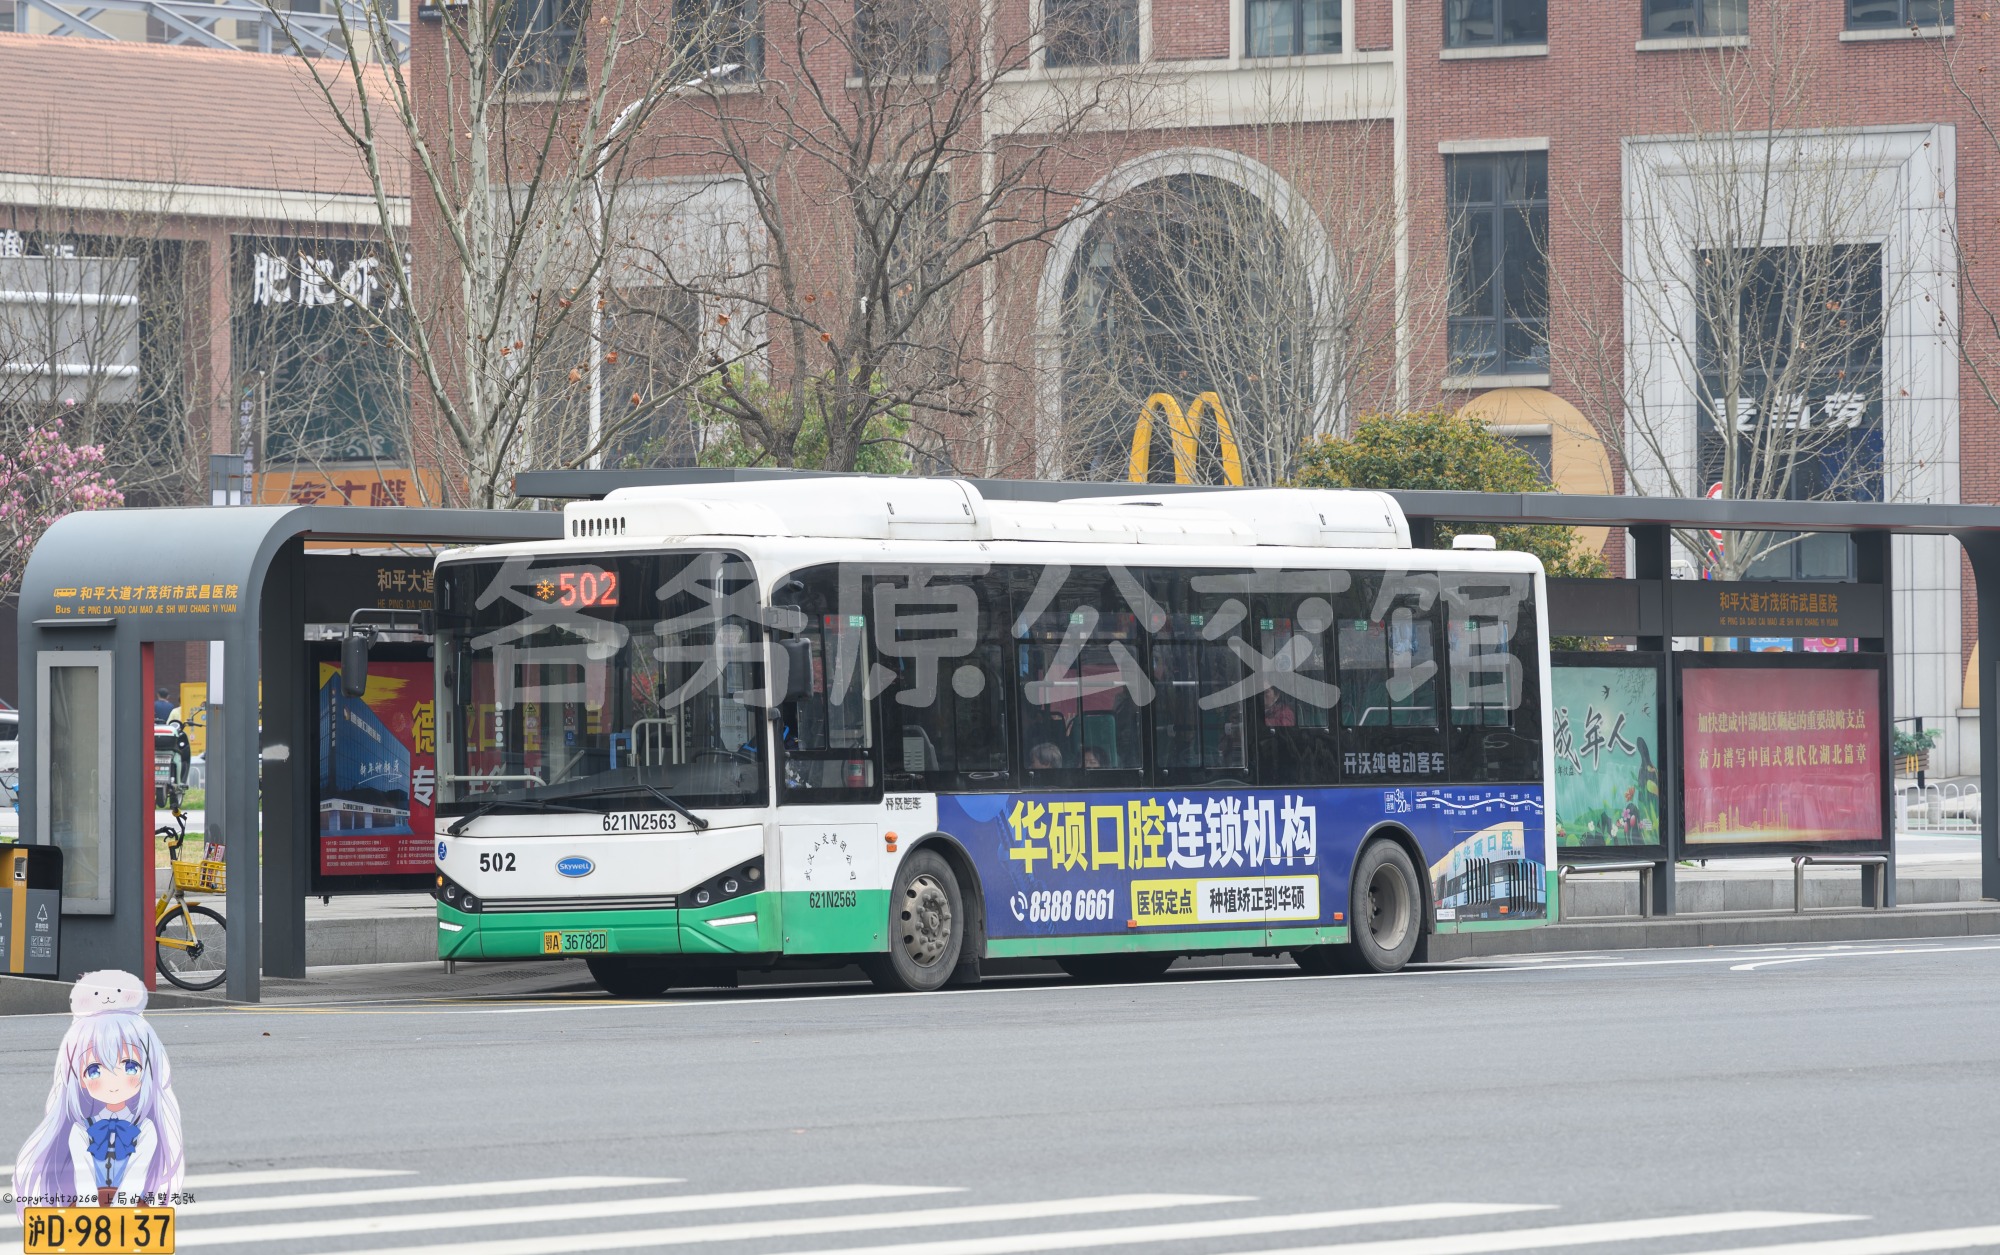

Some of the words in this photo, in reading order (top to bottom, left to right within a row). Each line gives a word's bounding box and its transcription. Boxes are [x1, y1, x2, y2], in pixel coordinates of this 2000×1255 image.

[377, 568, 434, 593] 和平大道
[559, 571, 618, 606] 502
[80, 584, 239, 600] 和平大道才茂街市武昌医院
[1719, 592, 1838, 613] 和平大道才茂街市武昌医院
[55, 604, 71, 614] Bus
[78, 606, 85, 614] HE
[88, 606, 100, 614] PING
[104, 606, 111, 614] DA
[128, 606, 137, 614] CAI
[140, 606, 153, 614] MAO
[156, 605, 164, 613] JIE
[166, 605, 176, 613] SHI
[178, 605, 188, 613] WU
[190, 605, 210, 613] CHANG
[212, 604, 218, 612] YI
[220, 604, 236, 612] YUAN
[1344, 752, 1445, 775] 开沃纯电动客车
[1699, 743, 1866, 769] 奋力谱写中国式现代化湖北篇章
[602, 813, 677, 832] 621N2563
[1008, 795, 1317, 874] 华硕口腔连锁机构
[479, 853, 516, 873] 502
[809, 890, 857, 909] 621N2563
[1029, 890, 1073, 923] 8388
[1074, 888, 1115, 920] 6661
[1136, 887, 1193, 916] 医保定点
[1209, 885, 1306, 913] 种植矫正到华硕
[564, 933, 606, 950] 36782D
